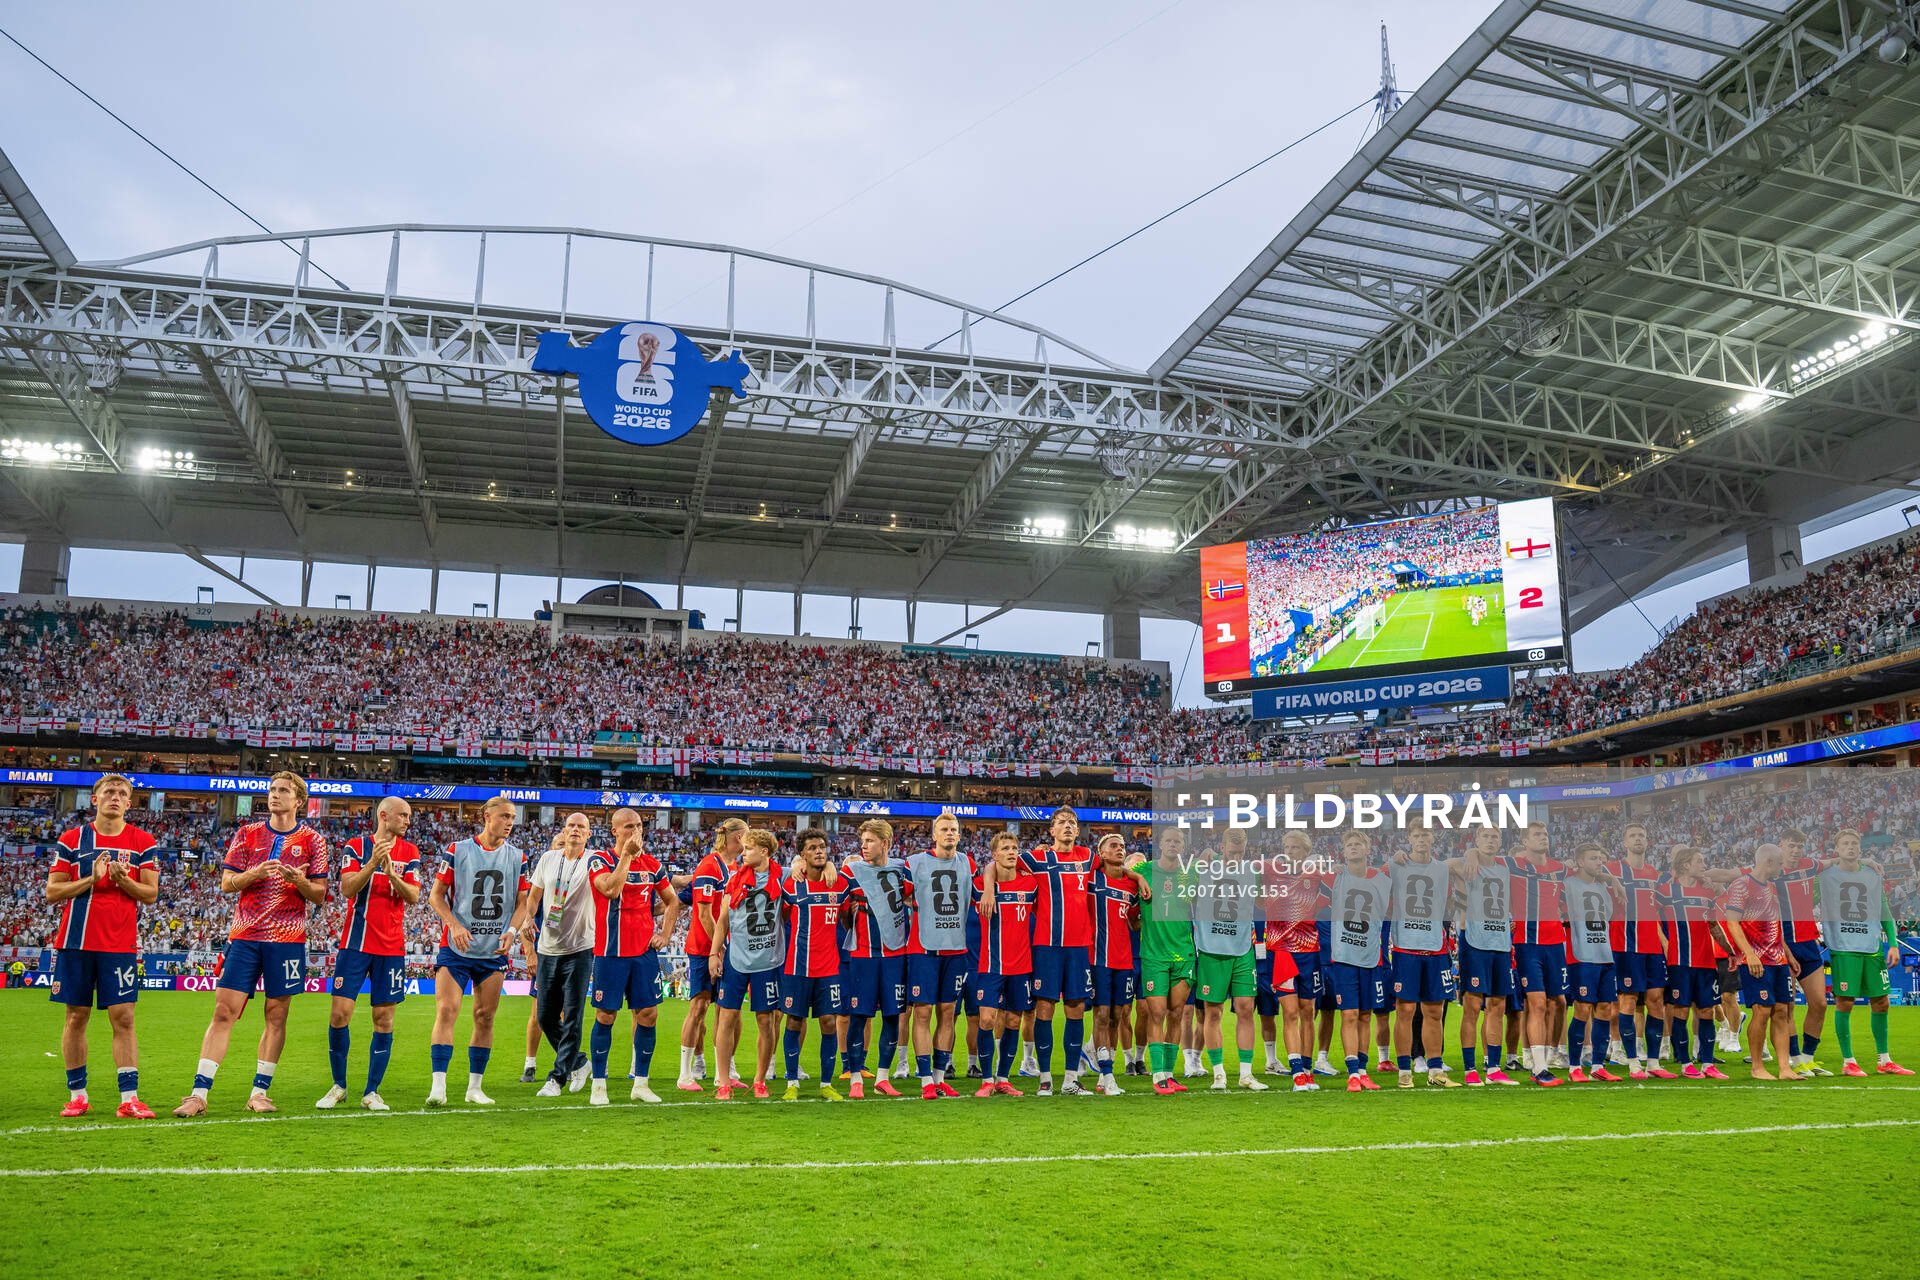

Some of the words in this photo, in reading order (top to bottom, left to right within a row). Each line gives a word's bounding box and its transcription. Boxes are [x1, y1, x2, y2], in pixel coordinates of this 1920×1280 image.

[632, 386, 658, 398] FIFA
[615, 404, 650, 415] WORLD
[652, 407, 672, 417] CUP
[613, 414, 671, 430] 2026
[1519, 587, 1543, 609] 2
[1216, 623, 1236, 643] 1
[1530, 650, 1544, 660] CC
[1218, 682, 1232, 691] CC
[1275, 694, 1312, 710] FIFA
[1314, 688, 1377, 706] WORLD
[1379, 684, 1415, 700] CUP
[1418, 677, 1483, 697] 2026
[448, 757, 492, 766] ENDZONE
[1752, 752, 1788, 767] MIAMI
[8, 771, 53, 782] MIAMI
[209, 778, 236, 789] FIFA
[310, 782, 352, 794] 2026
[500, 790, 540, 800] MIAMI
[724, 798, 769, 809] #FIFAWorldCup
[941, 805, 978, 816] MIAMI
[1102, 811, 1123, 820] FIFA
[1124, 812, 1159, 822] WORLD
[1160, 812, 1179, 821] CUP
[1077, 874, 1085, 891] 8
[640, 885, 649, 903] 4
[1015, 905, 1026, 922] 10
[1163, 900, 1169, 917] 1
[471, 927, 502, 935] 2026
[755, 925, 770, 933] FIFA
[1211, 927, 1237, 936] 2026
[1404, 922, 1432, 931] 2026
[748, 940, 776, 951] 2026
[1341, 936, 1368, 947] 2026
[283, 959, 301, 980] 18
[1561, 967, 1568, 983] 7
[114, 966, 135, 988] 16
[388, 967, 403, 988] 14
